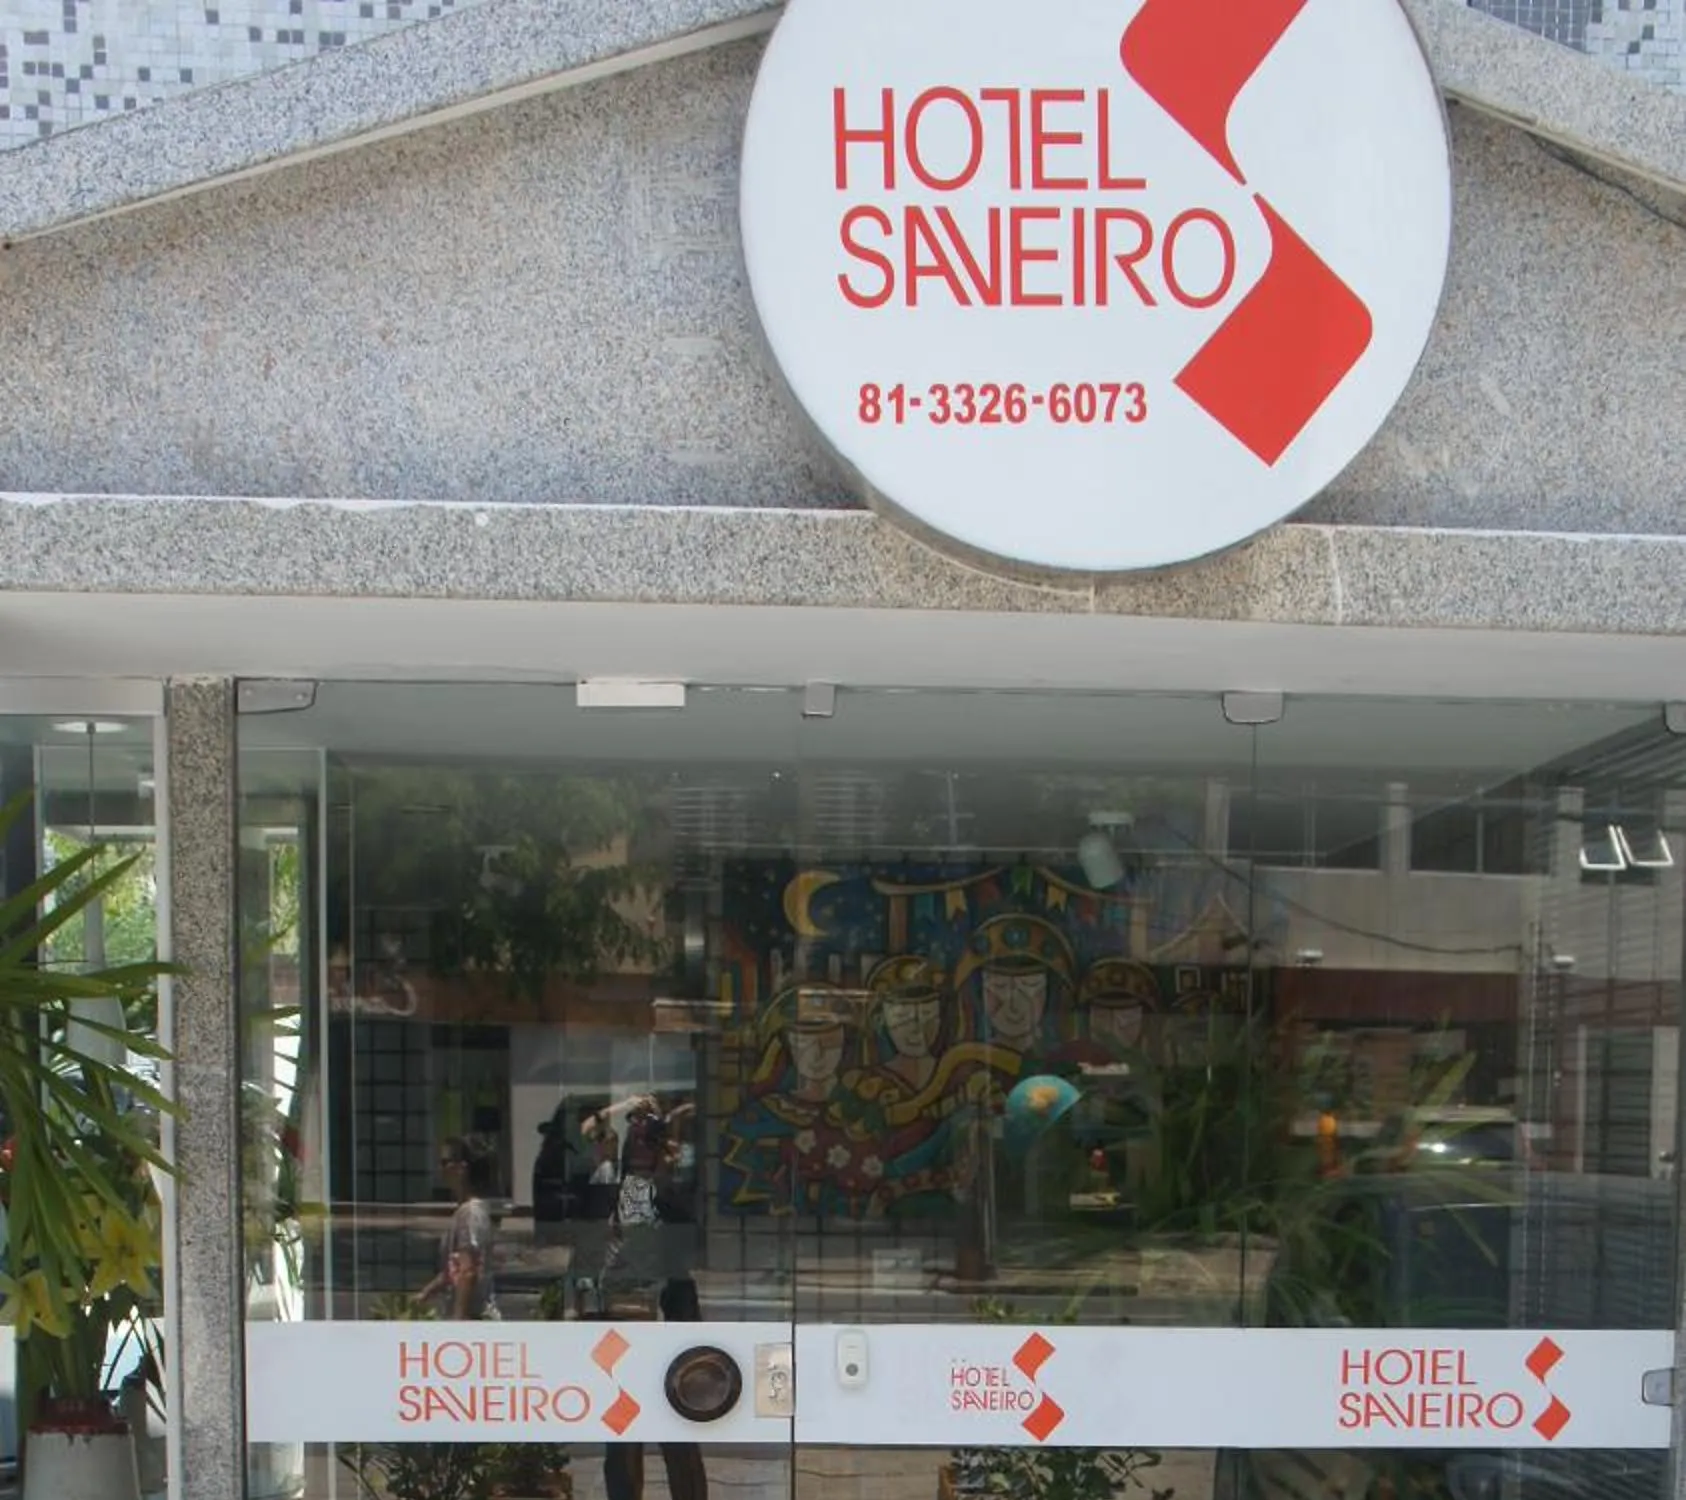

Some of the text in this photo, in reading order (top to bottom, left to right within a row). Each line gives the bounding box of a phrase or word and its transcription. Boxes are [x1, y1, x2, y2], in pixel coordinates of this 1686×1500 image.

[833, 86, 1146, 191] HOTEL
[837, 205, 1236, 309] SAVEIRO
[857, 382, 1148, 425] 81-3326-6073
[399, 1341, 542, 1379] HOTEL
[951, 1367, 1010, 1387] HOTEL
[1341, 1349, 1476, 1386] HOTEL
